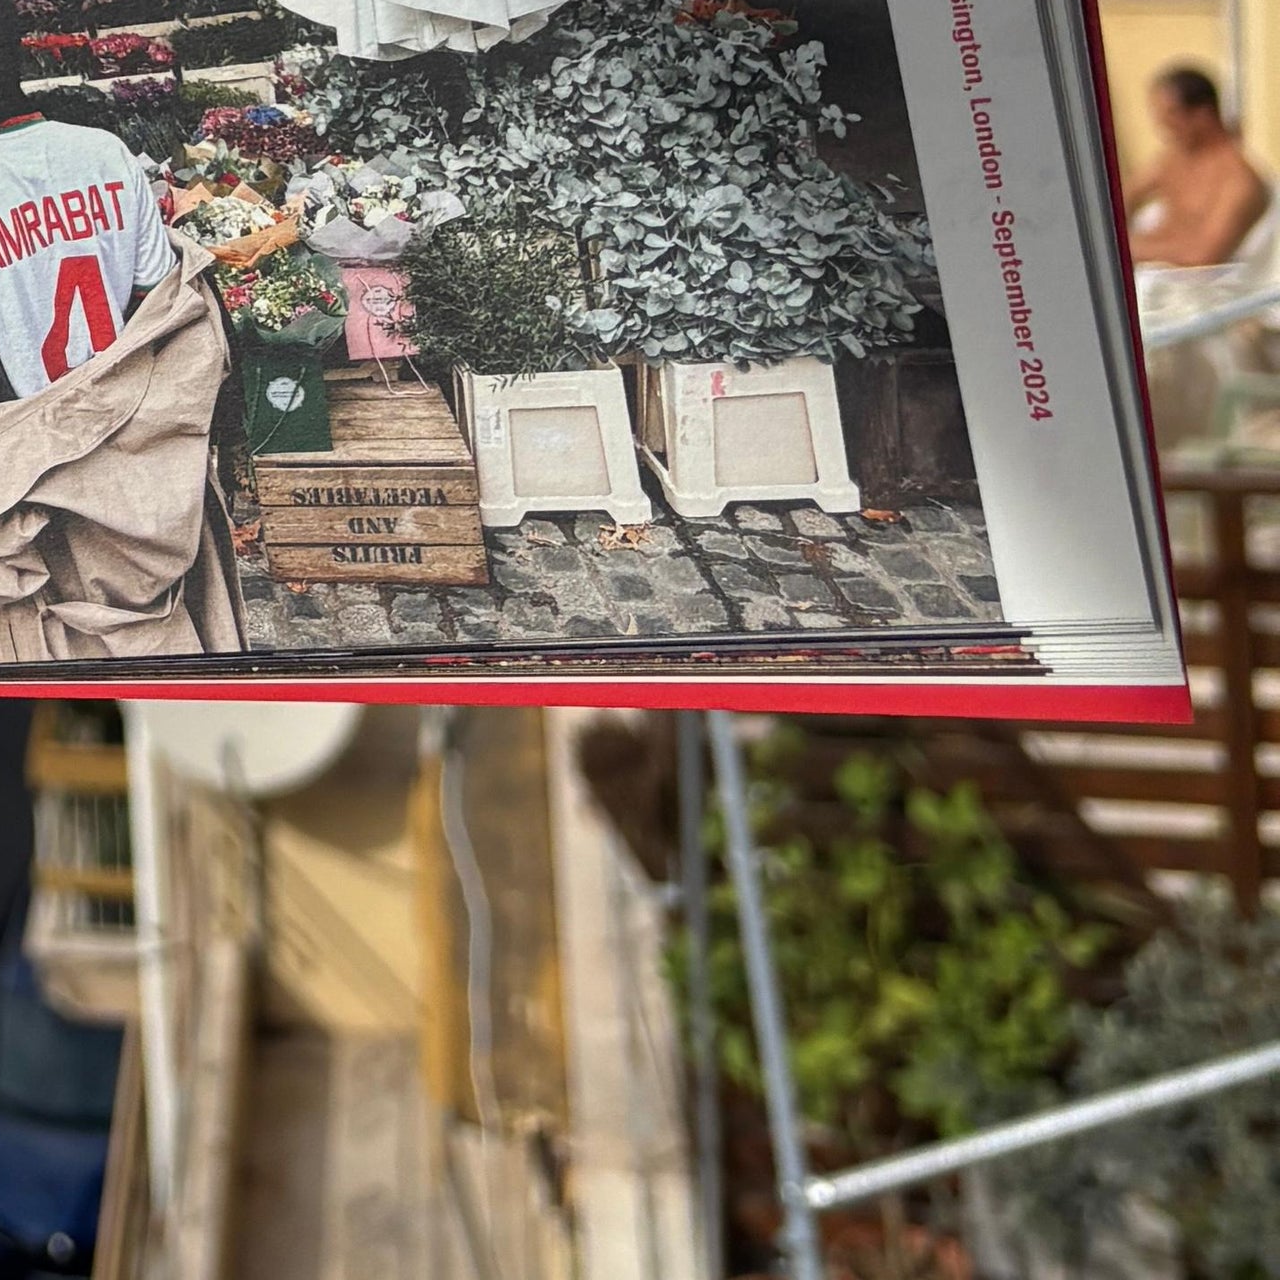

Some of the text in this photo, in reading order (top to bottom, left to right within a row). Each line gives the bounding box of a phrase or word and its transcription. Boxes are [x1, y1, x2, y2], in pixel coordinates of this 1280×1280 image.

[970, 97, 1003, 189] London
[992, 209, 1034, 352] September
[1019, 357, 1053, 421] 2024
[41, 254, 119, 383] 4
[291, 486, 449, 505] VEGETABLES
[348, 517, 400, 534] AND
[332, 545, 424, 564] FRUITS
